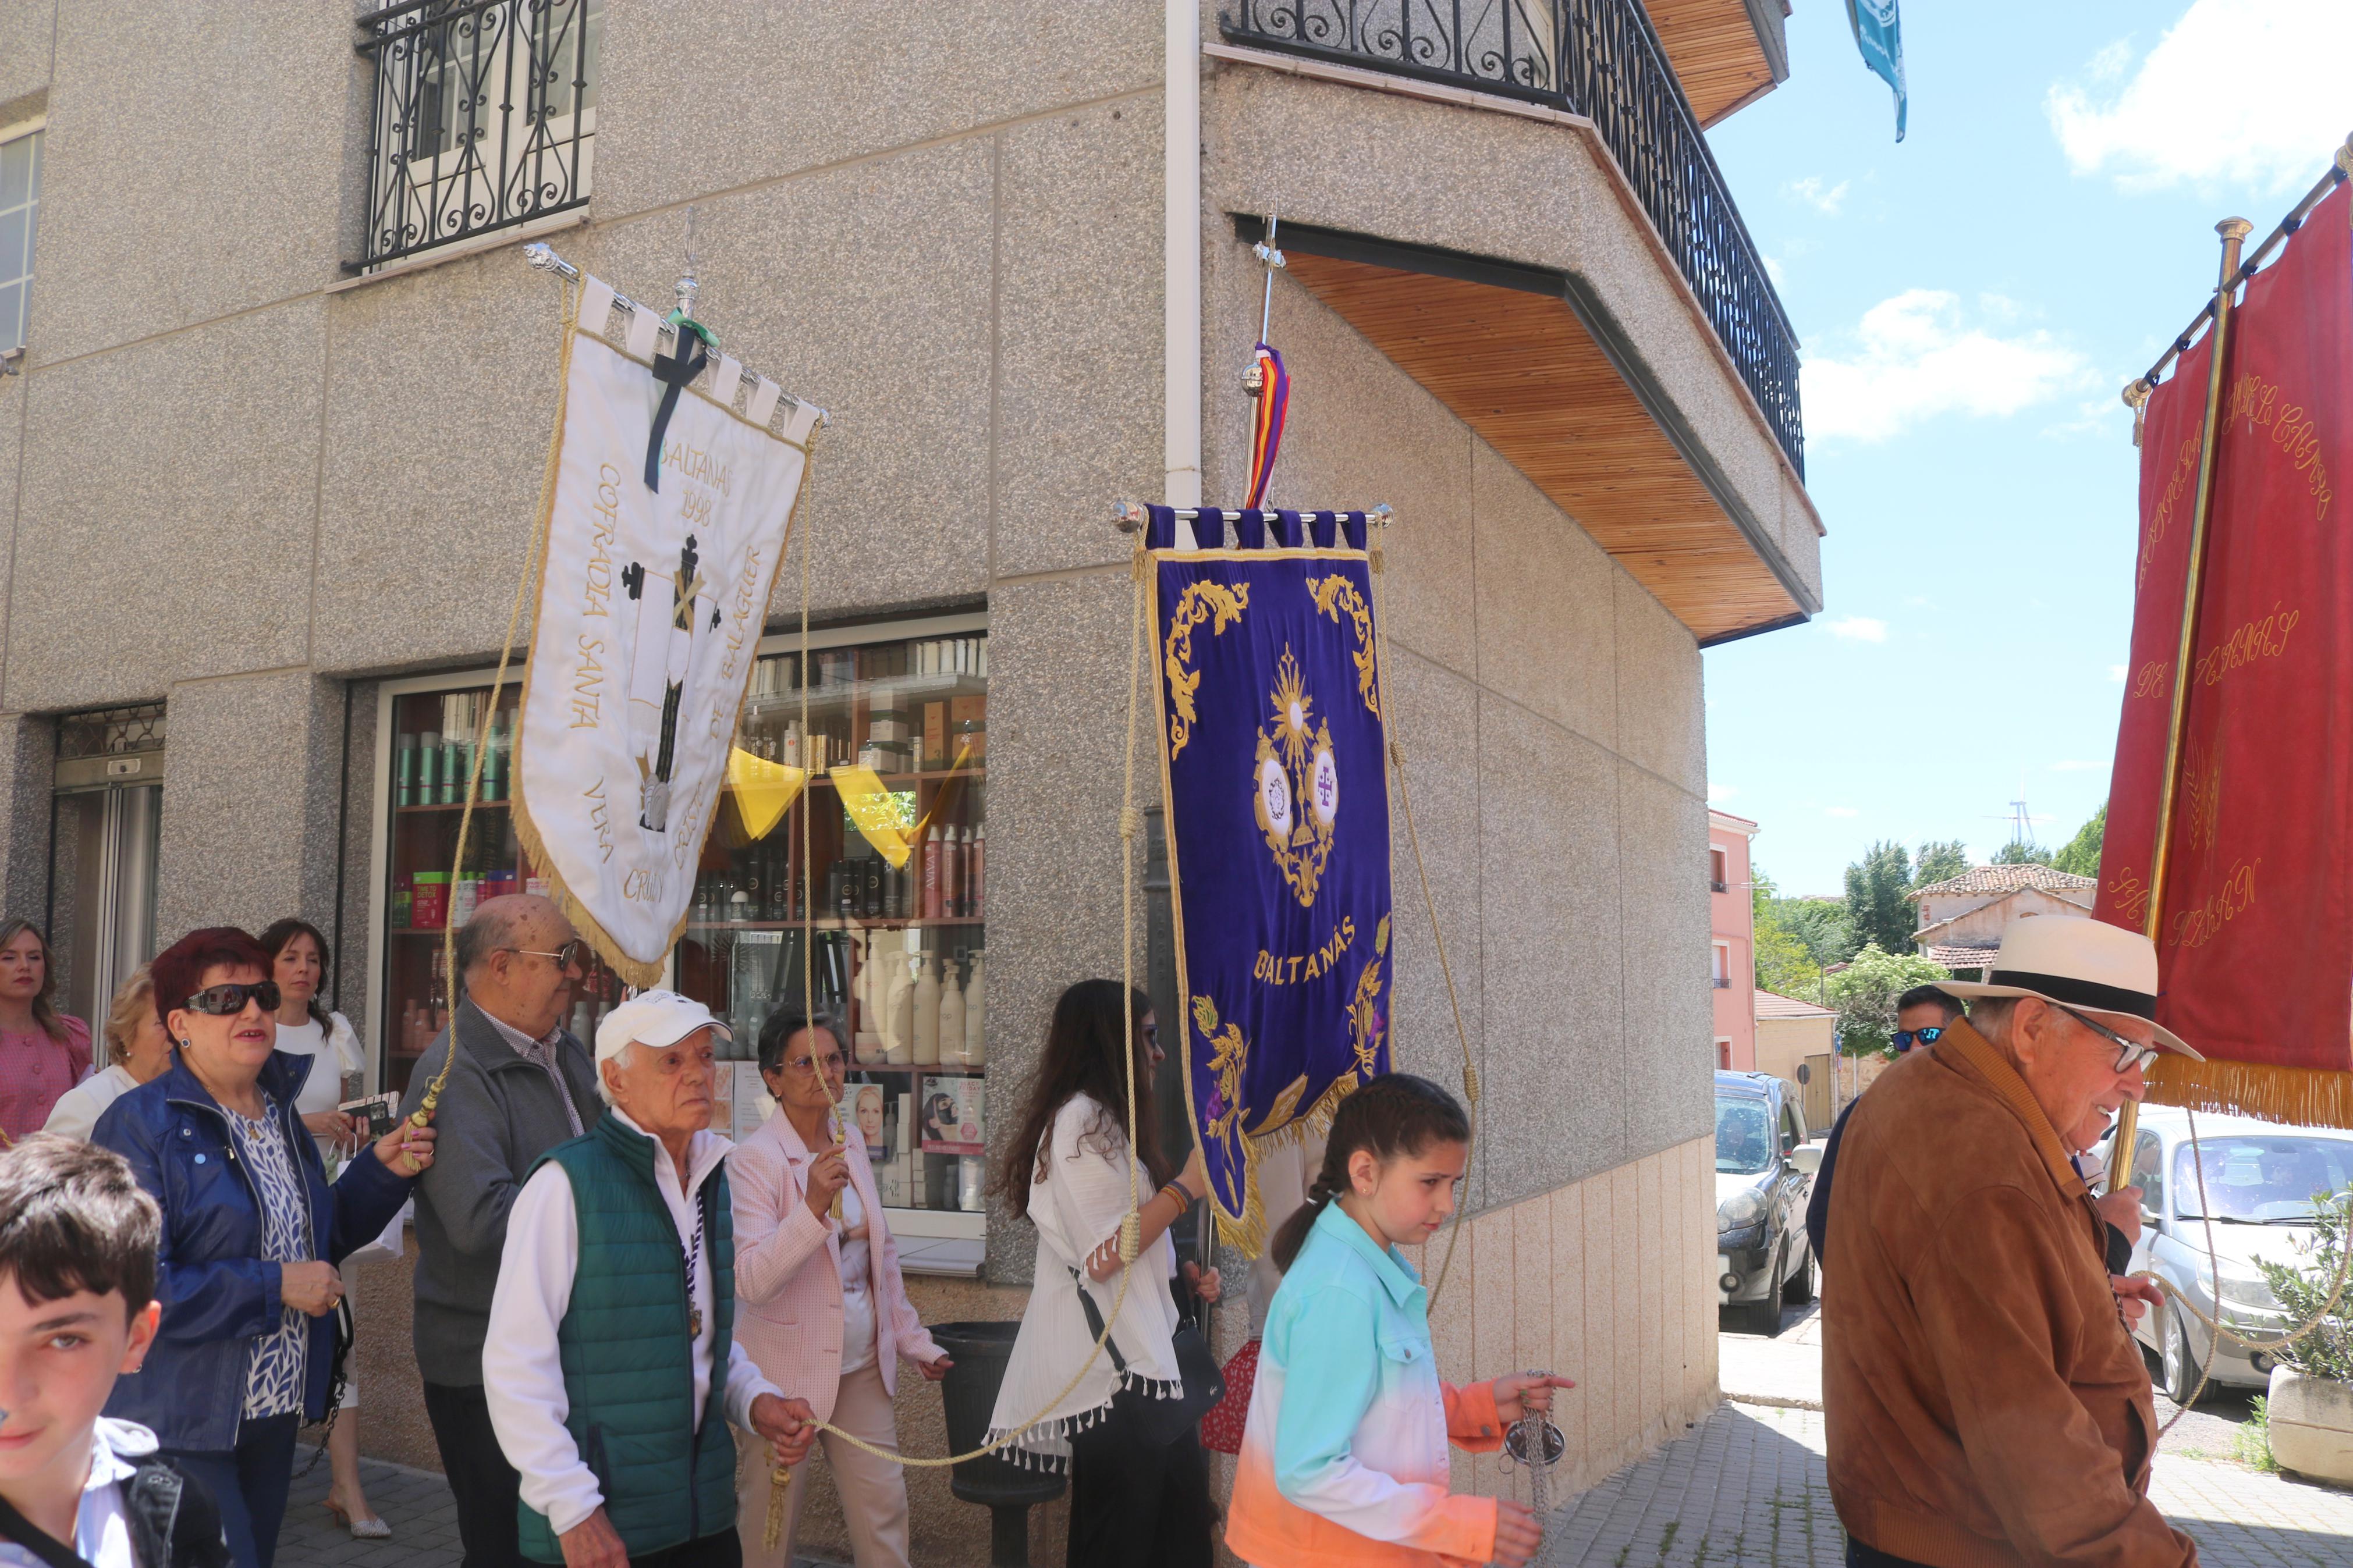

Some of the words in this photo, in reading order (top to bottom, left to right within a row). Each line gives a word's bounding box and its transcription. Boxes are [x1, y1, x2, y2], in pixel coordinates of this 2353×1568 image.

[583, 463, 620, 617] COFRADIA
[682, 489, 712, 527] 1998
[722, 545, 760, 680] BALAGUER
[570, 634, 605, 729] SANTA
[710, 699, 723, 740] DE
[2133, 661, 2169, 699] DE
[583, 776, 614, 864] VERA
[1254, 915, 1355, 986] BALTANÁS
